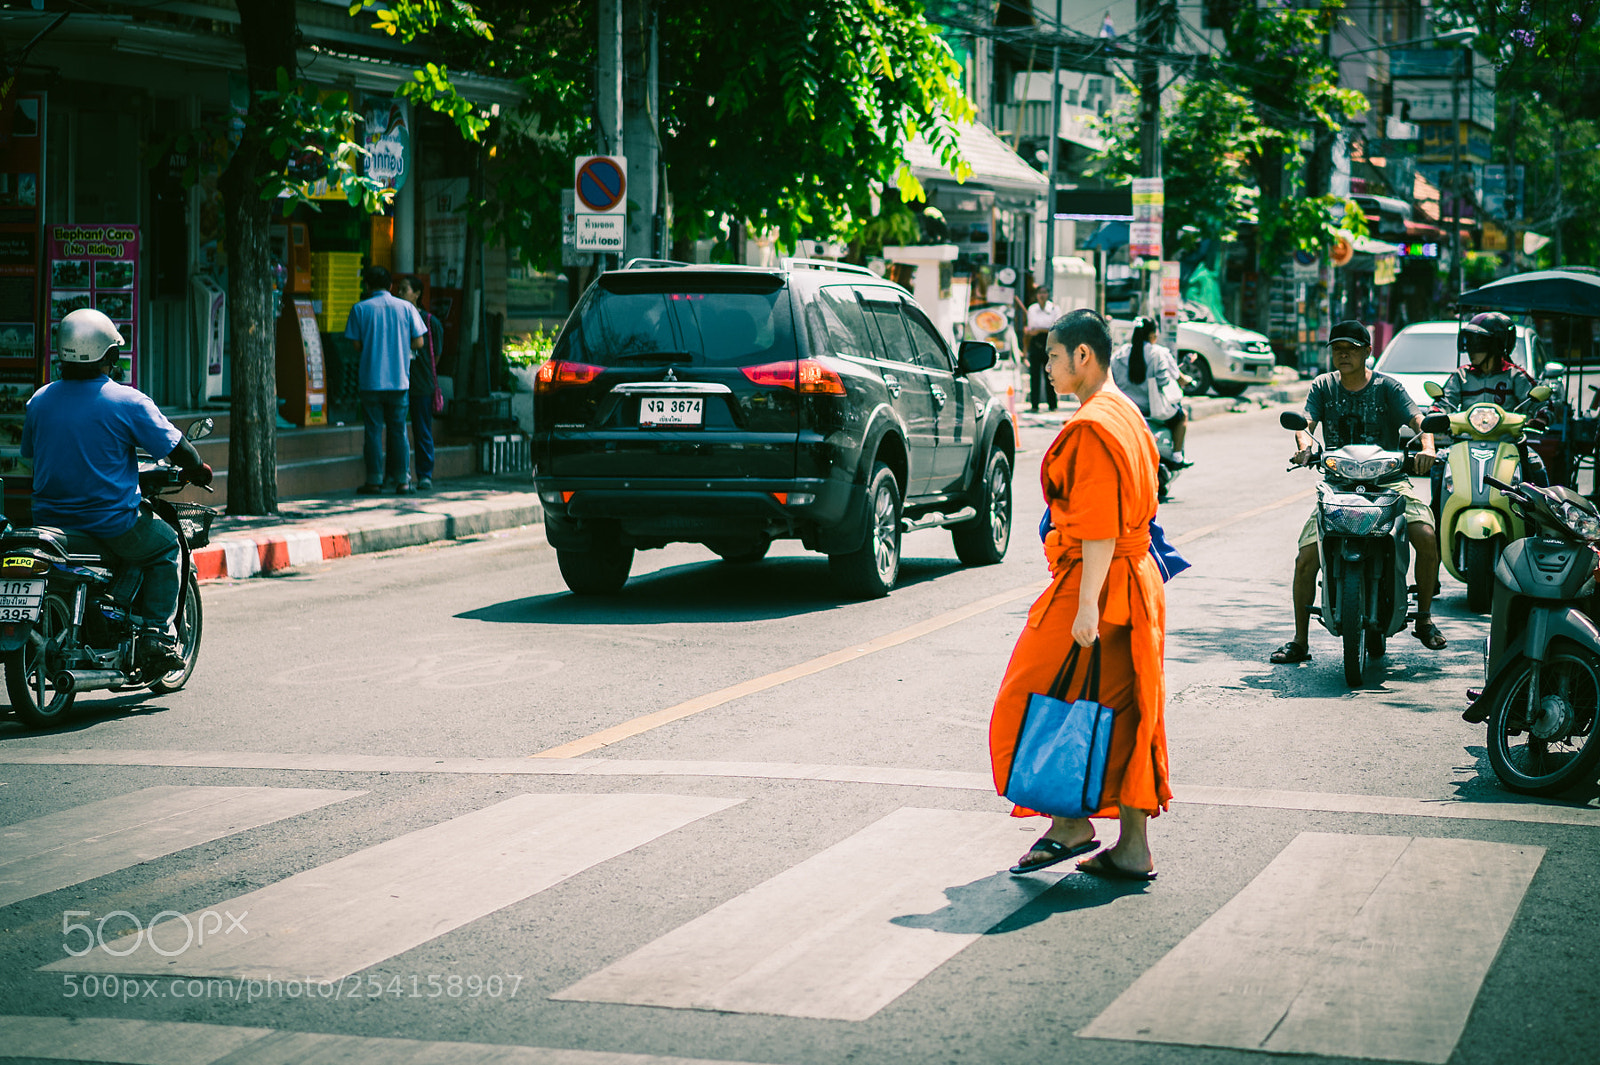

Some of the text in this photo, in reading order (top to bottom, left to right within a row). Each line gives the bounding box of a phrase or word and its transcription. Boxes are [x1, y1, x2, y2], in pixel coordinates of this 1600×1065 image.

[54, 227, 135, 243] Elephant Care
[598, 236, 622, 247] (ODD)
[648, 400, 700, 413] งฉ 3674
[16, 558, 32, 566] LPG
[3, 582, 32, 594] 1กร
[0, 609, 31, 620] 395
